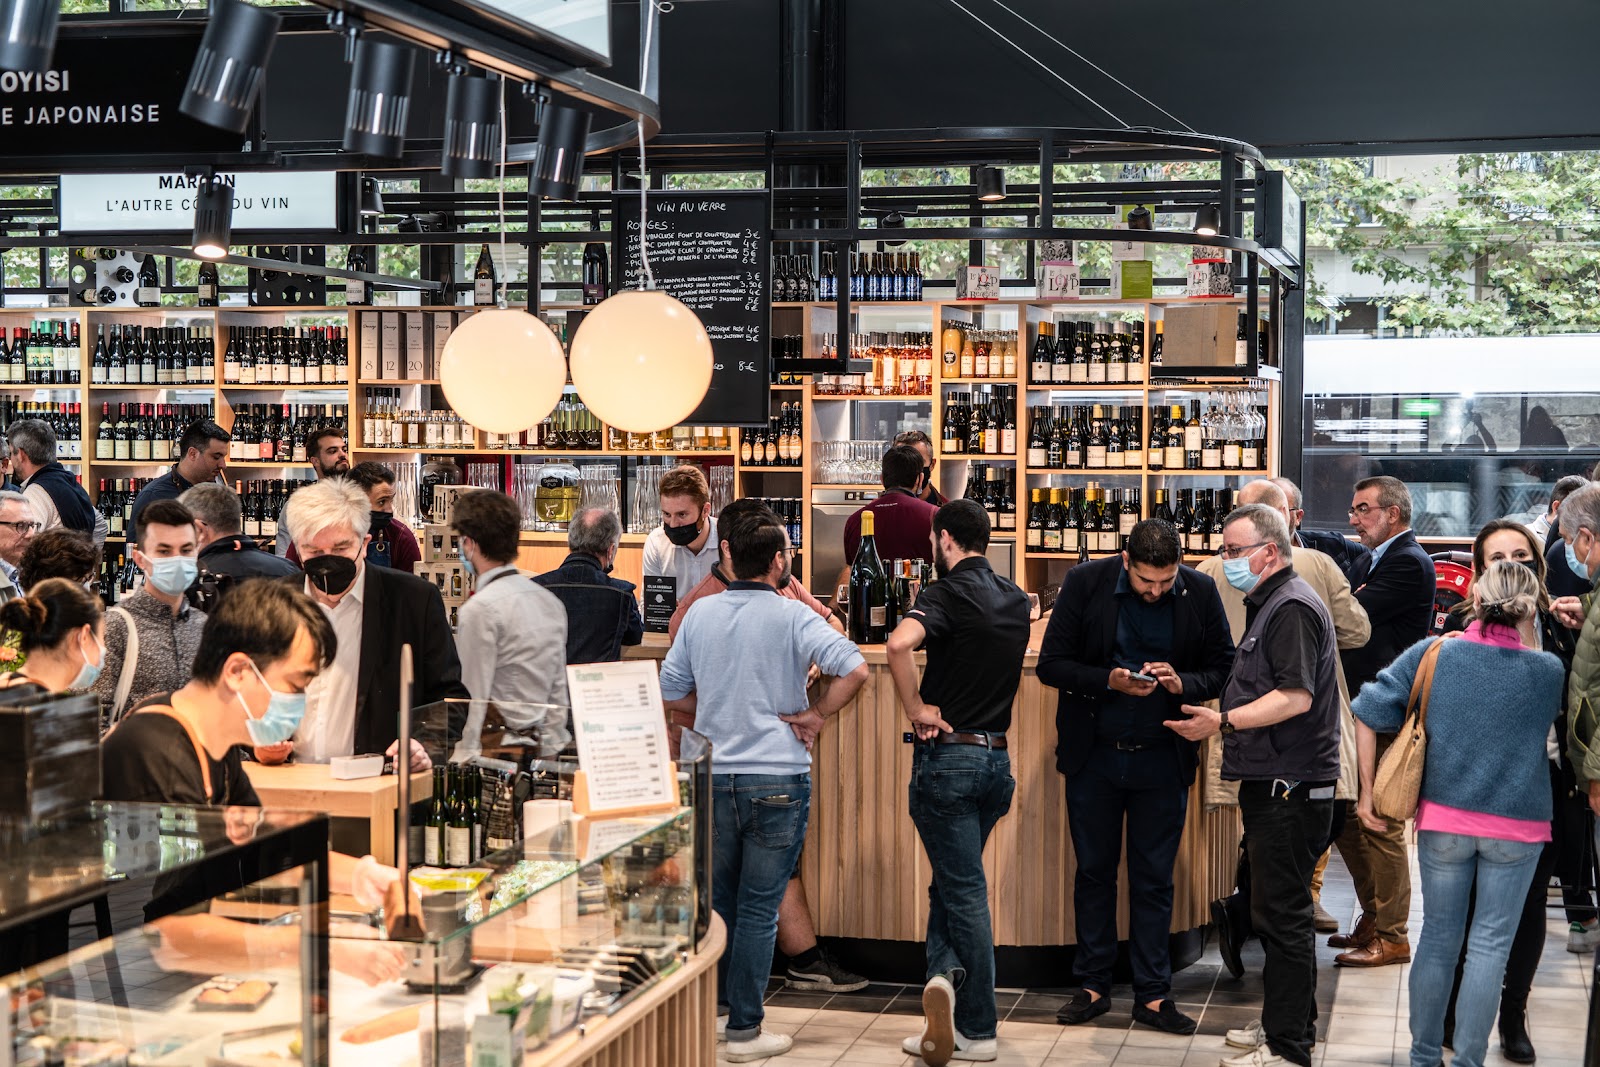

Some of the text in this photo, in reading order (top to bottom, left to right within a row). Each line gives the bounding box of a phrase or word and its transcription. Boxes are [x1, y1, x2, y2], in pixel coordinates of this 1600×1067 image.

[0, 70, 69, 93] OYISI
[24, 104, 160, 126] JAPONAISE
[106, 198, 173, 212] L'AUTRE
[261, 197, 289, 209] VIN
[680, 202, 694, 212] AU
[365, 360, 373, 371] 8
[386, 360, 395, 371] 12
[408, 360, 423, 371] 20
